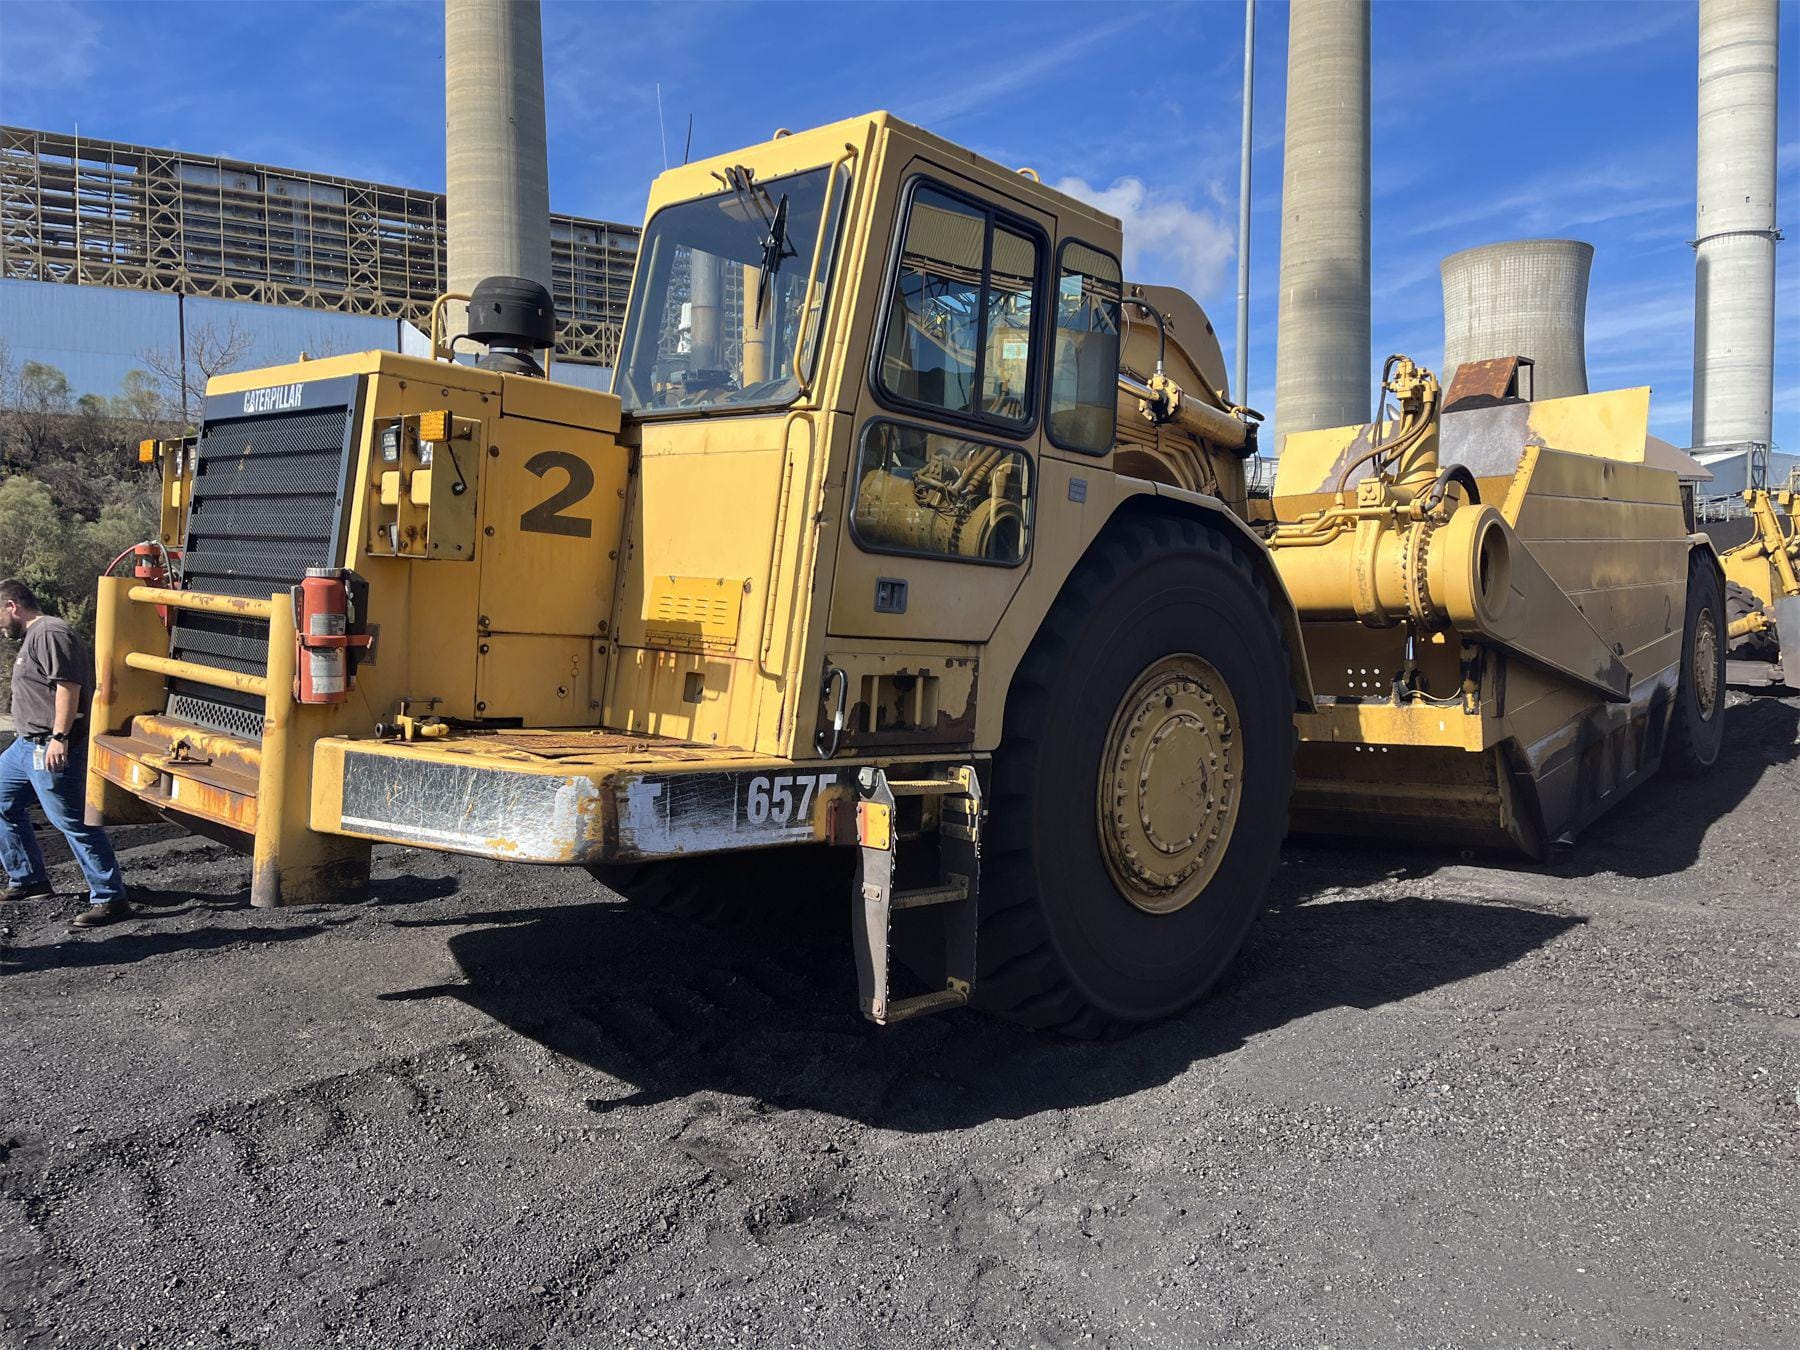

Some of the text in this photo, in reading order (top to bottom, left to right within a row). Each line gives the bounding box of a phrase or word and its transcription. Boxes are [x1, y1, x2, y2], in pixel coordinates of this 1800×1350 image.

[244, 383, 304, 413] CATERPILLAR
[520, 451, 595, 539] 2
[1664, 594, 1672, 634] 2
